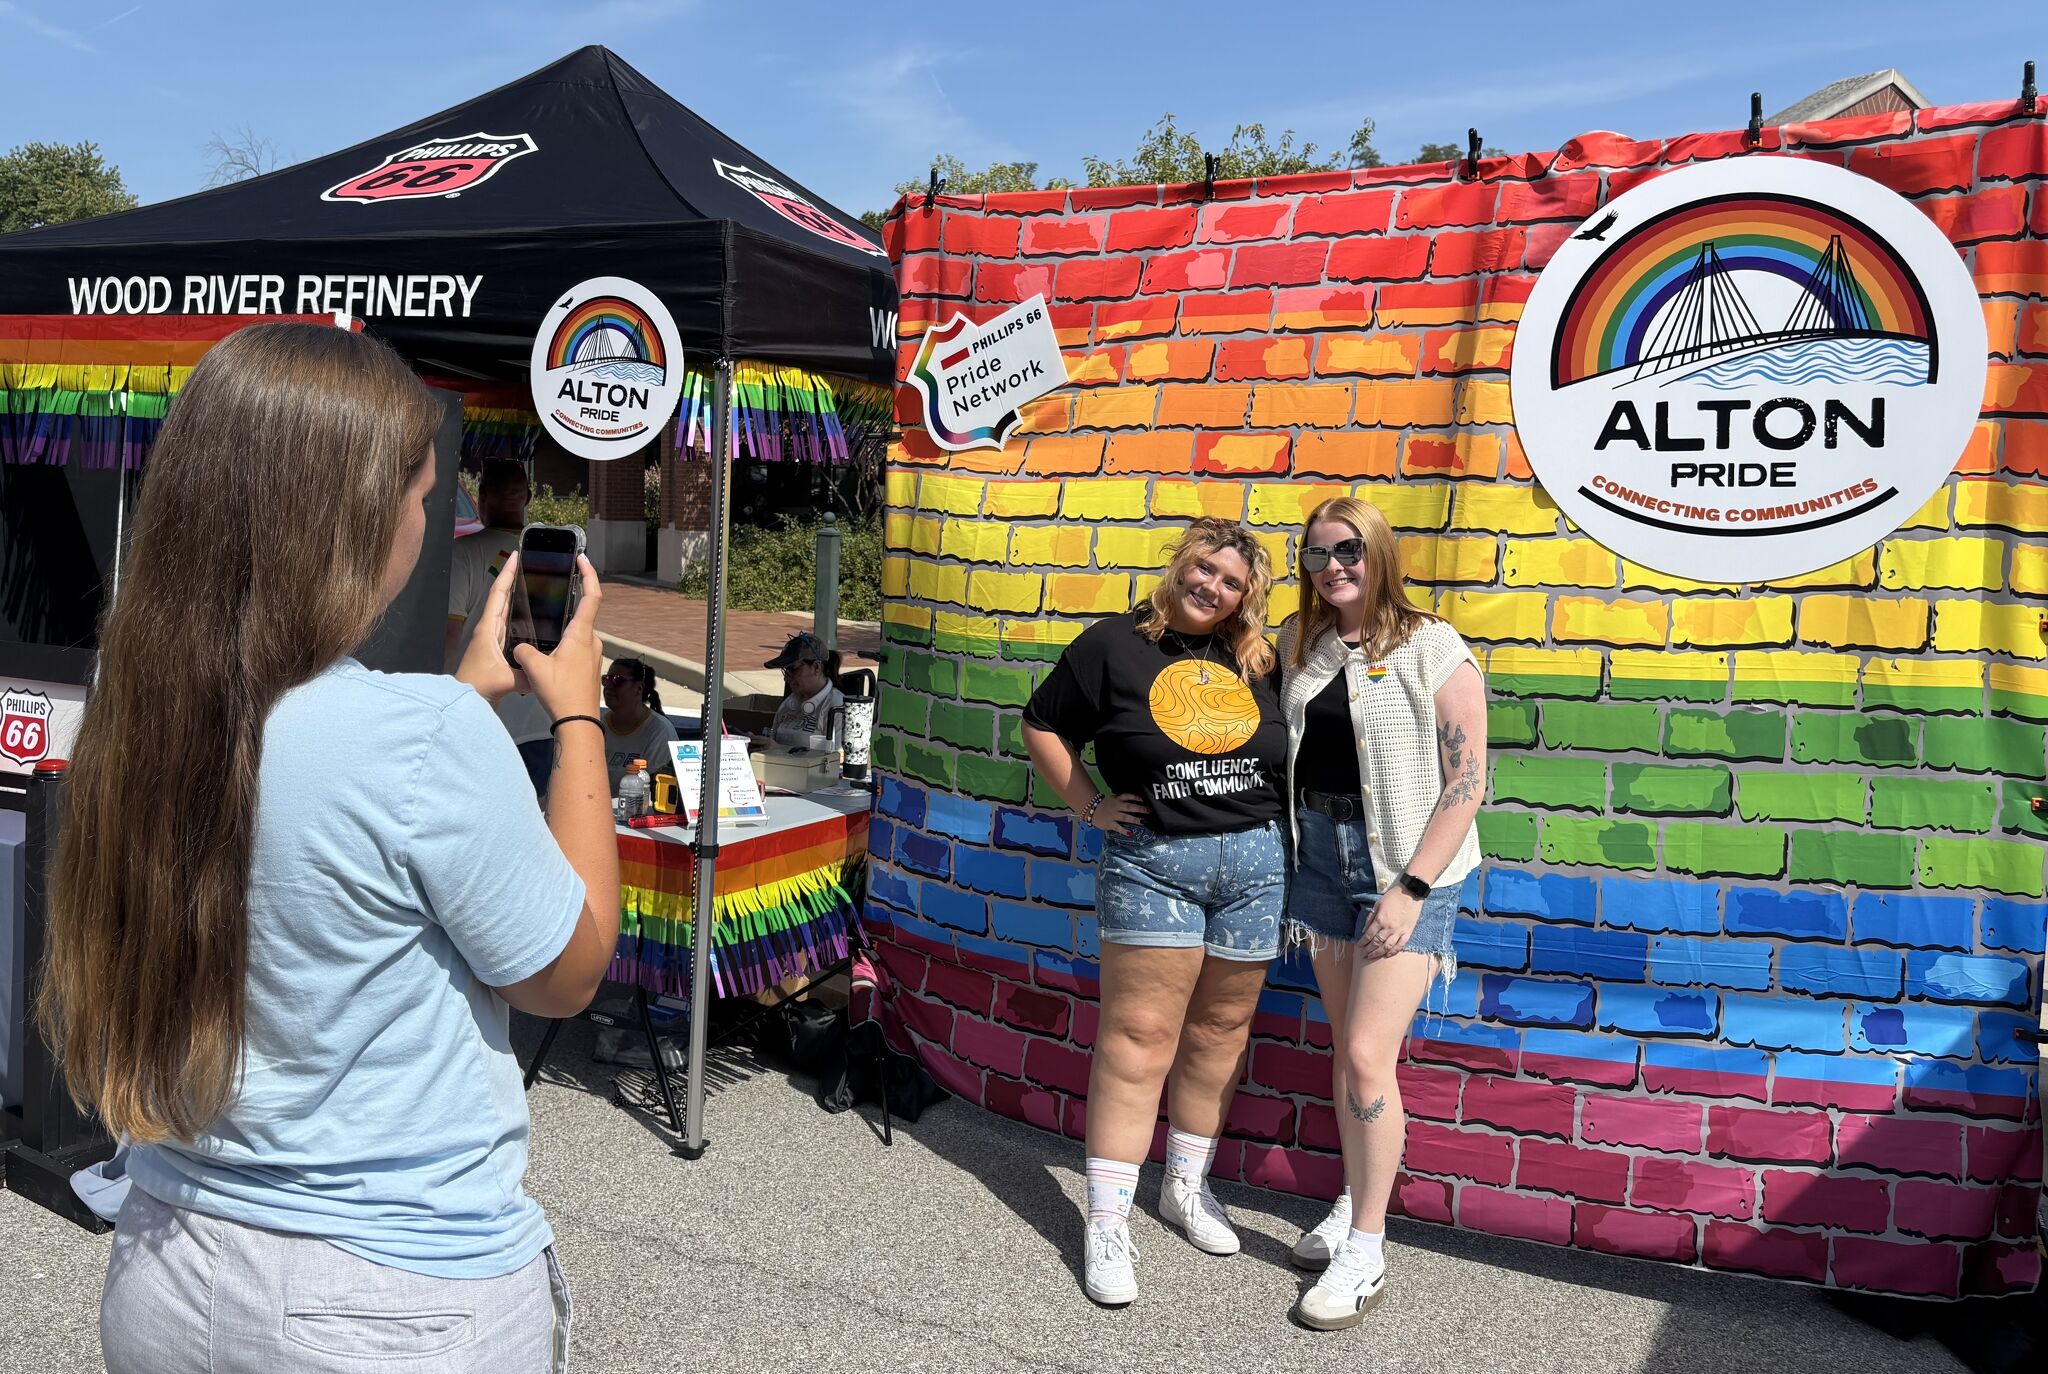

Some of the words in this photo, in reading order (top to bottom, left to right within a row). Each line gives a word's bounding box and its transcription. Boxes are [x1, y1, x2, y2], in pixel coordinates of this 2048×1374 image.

[398, 143, 517, 162] PHILLIPS
[356, 163, 474, 191] 66
[781, 202, 857, 241] 66
[68, 276, 172, 315] WOOD
[182, 275, 285, 315] RIVER
[296, 275, 484, 317] REFINERY
[972, 318, 1024, 354] PHILLIPS
[1026, 308, 1042, 324] 66
[946, 357, 1002, 395] Pride
[953, 359, 1045, 417] Network
[557, 378, 649, 410] ALTON
[555, 408, 595, 434] CONNECTING
[595, 421, 644, 435] COMMUNITIES
[580, 407, 620, 422] PRIDE
[1594, 397, 1885, 451] ALTON
[1670, 462, 1796, 487] PRIDE
[1592, 474, 1720, 522] CONNECTING
[1725, 477, 1879, 522] COMMUNITIES
[7, 698, 46, 716] PHILLIPS
[6, 719, 41, 750] 66
[1165, 758, 1259, 780] CONFLUENCE
[1152, 781, 1192, 800] FAITH
